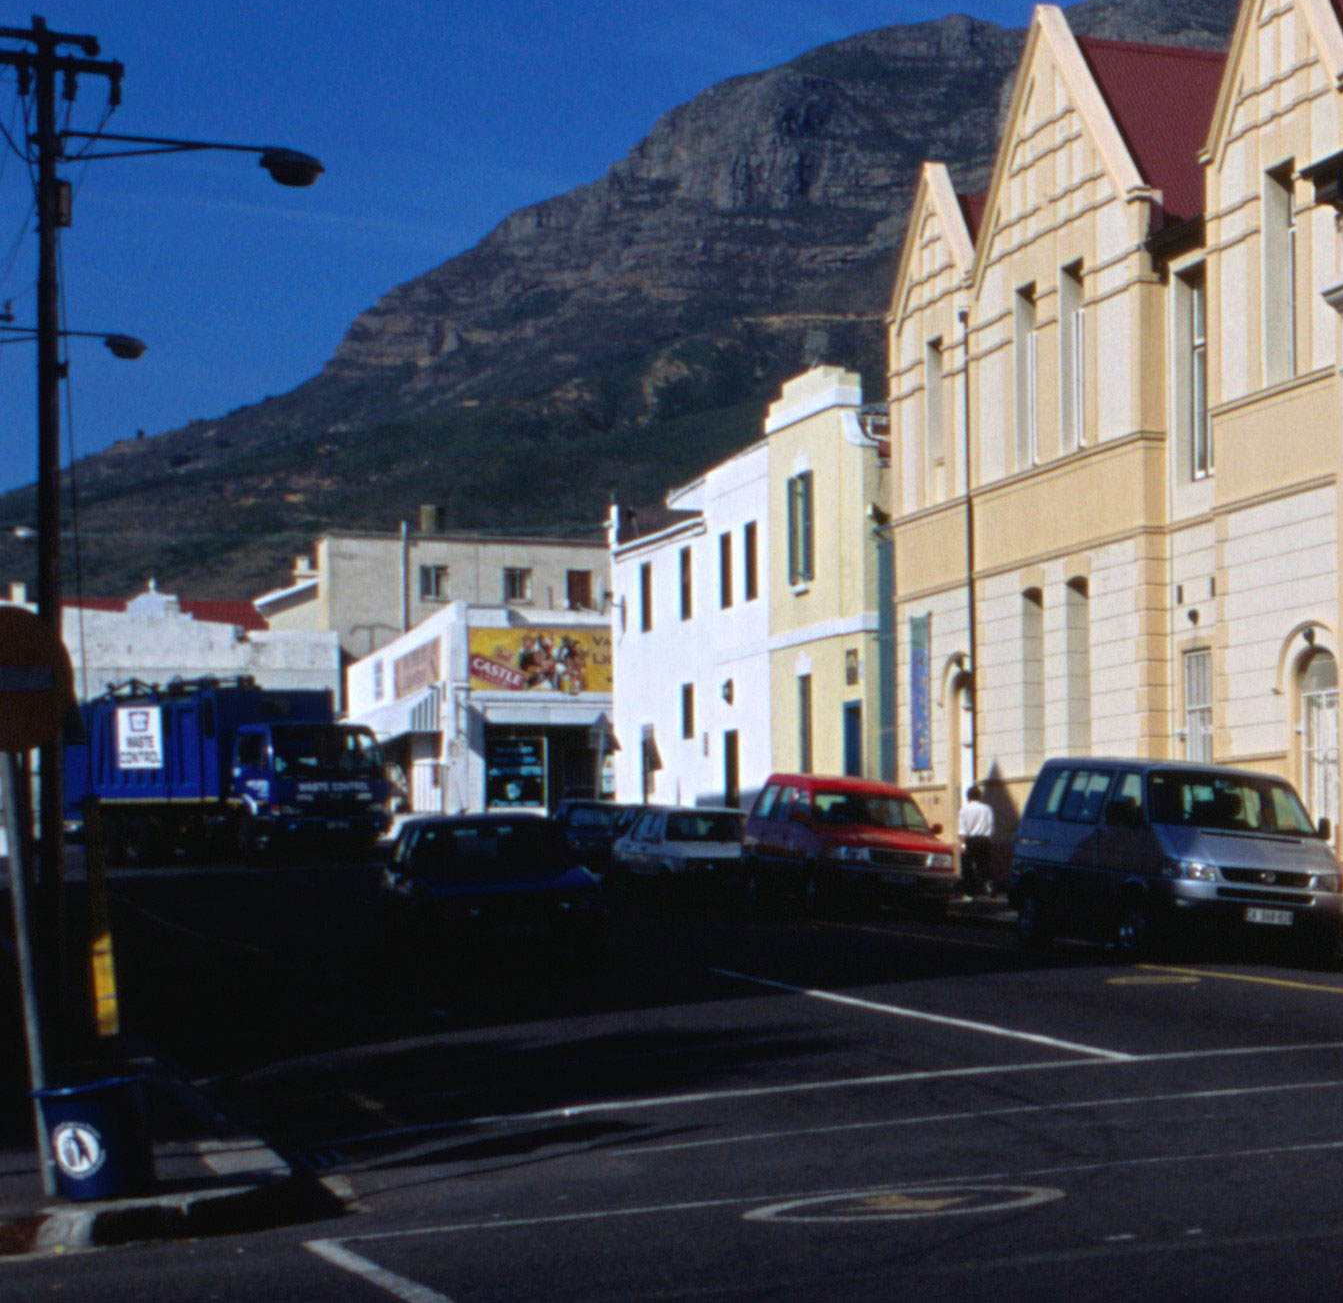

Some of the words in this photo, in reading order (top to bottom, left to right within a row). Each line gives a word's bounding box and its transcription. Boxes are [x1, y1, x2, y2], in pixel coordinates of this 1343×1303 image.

[472, 656, 521, 686] CASTLE
[127, 735, 154, 748] WASTE
[119, 752, 161, 764] CONTROL
[298, 782, 329, 792] WASTE
[332, 781, 369, 792] CONTROL
